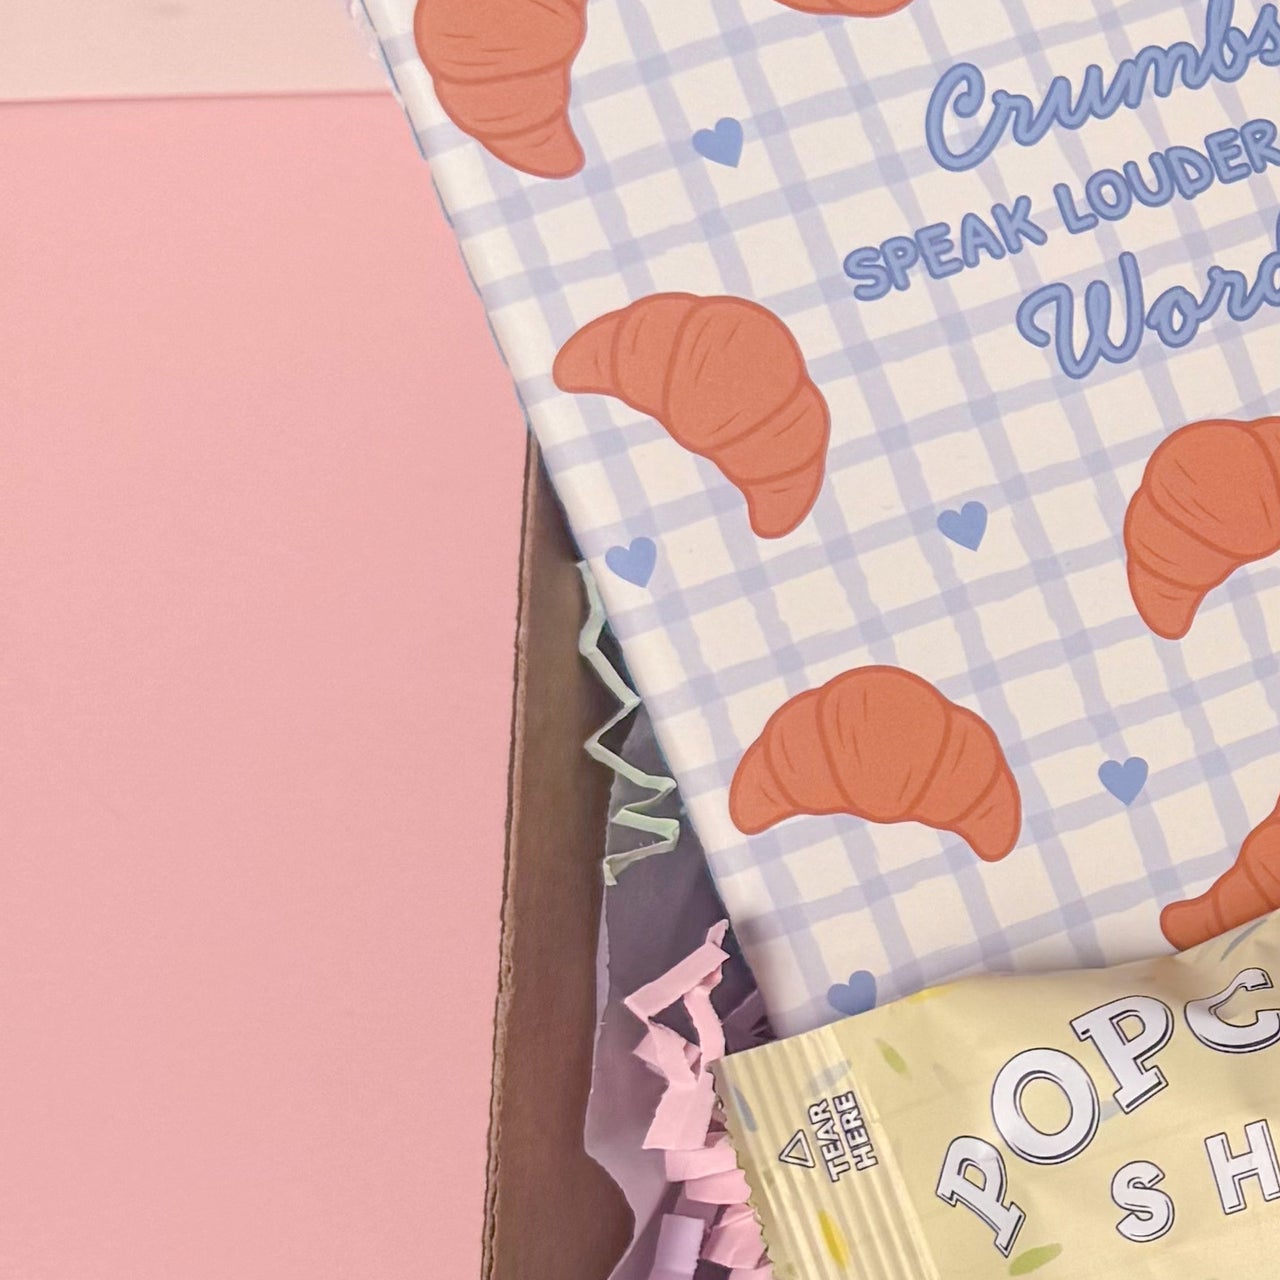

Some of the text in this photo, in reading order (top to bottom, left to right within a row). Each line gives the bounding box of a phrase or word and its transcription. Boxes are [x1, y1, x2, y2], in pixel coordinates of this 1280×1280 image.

[843, 196, 1048, 301] SPEAK
[808, 1098, 850, 1183] TEAR
[832, 1091, 879, 1171] HERE
